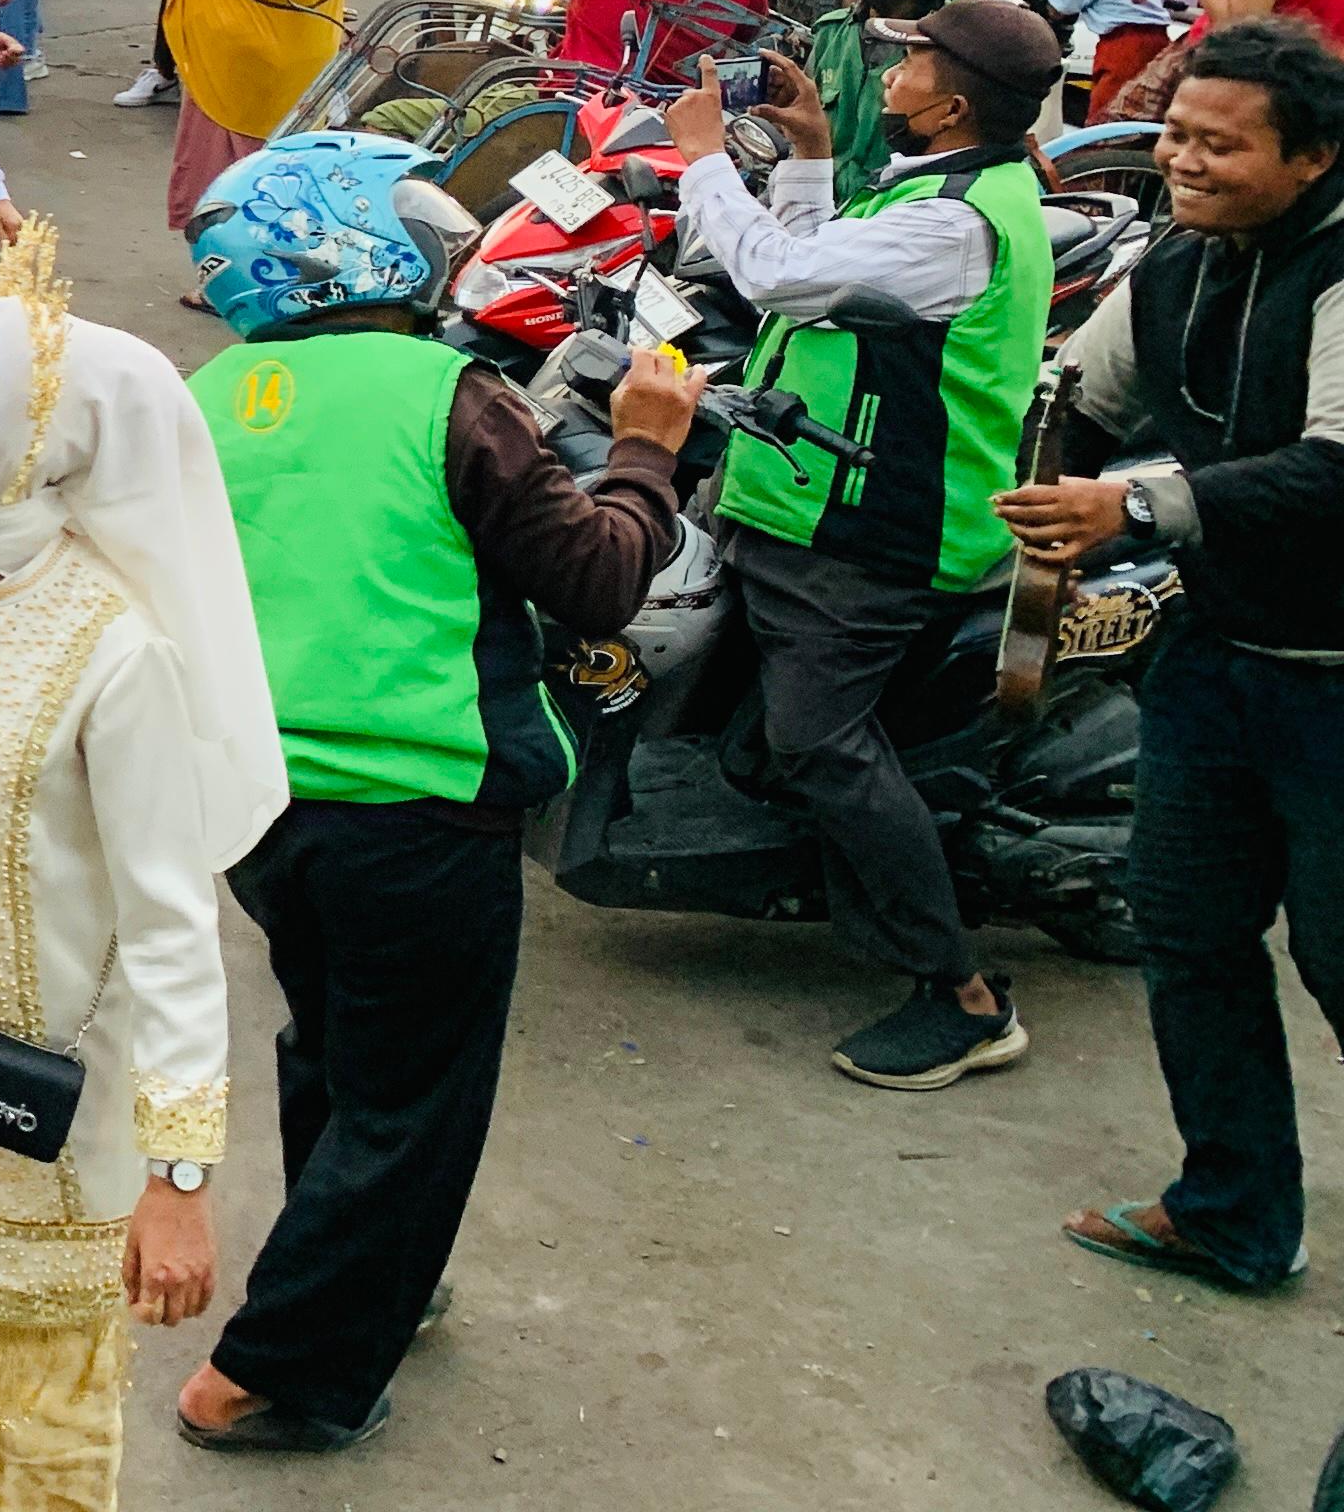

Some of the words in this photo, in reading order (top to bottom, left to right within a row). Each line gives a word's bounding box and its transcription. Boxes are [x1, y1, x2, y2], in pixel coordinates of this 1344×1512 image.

[534, 153, 555, 170] H
[548, 166, 585, 193] 4425
[524, 311, 565, 326] HOND
[245, 373, 282, 419] 14
